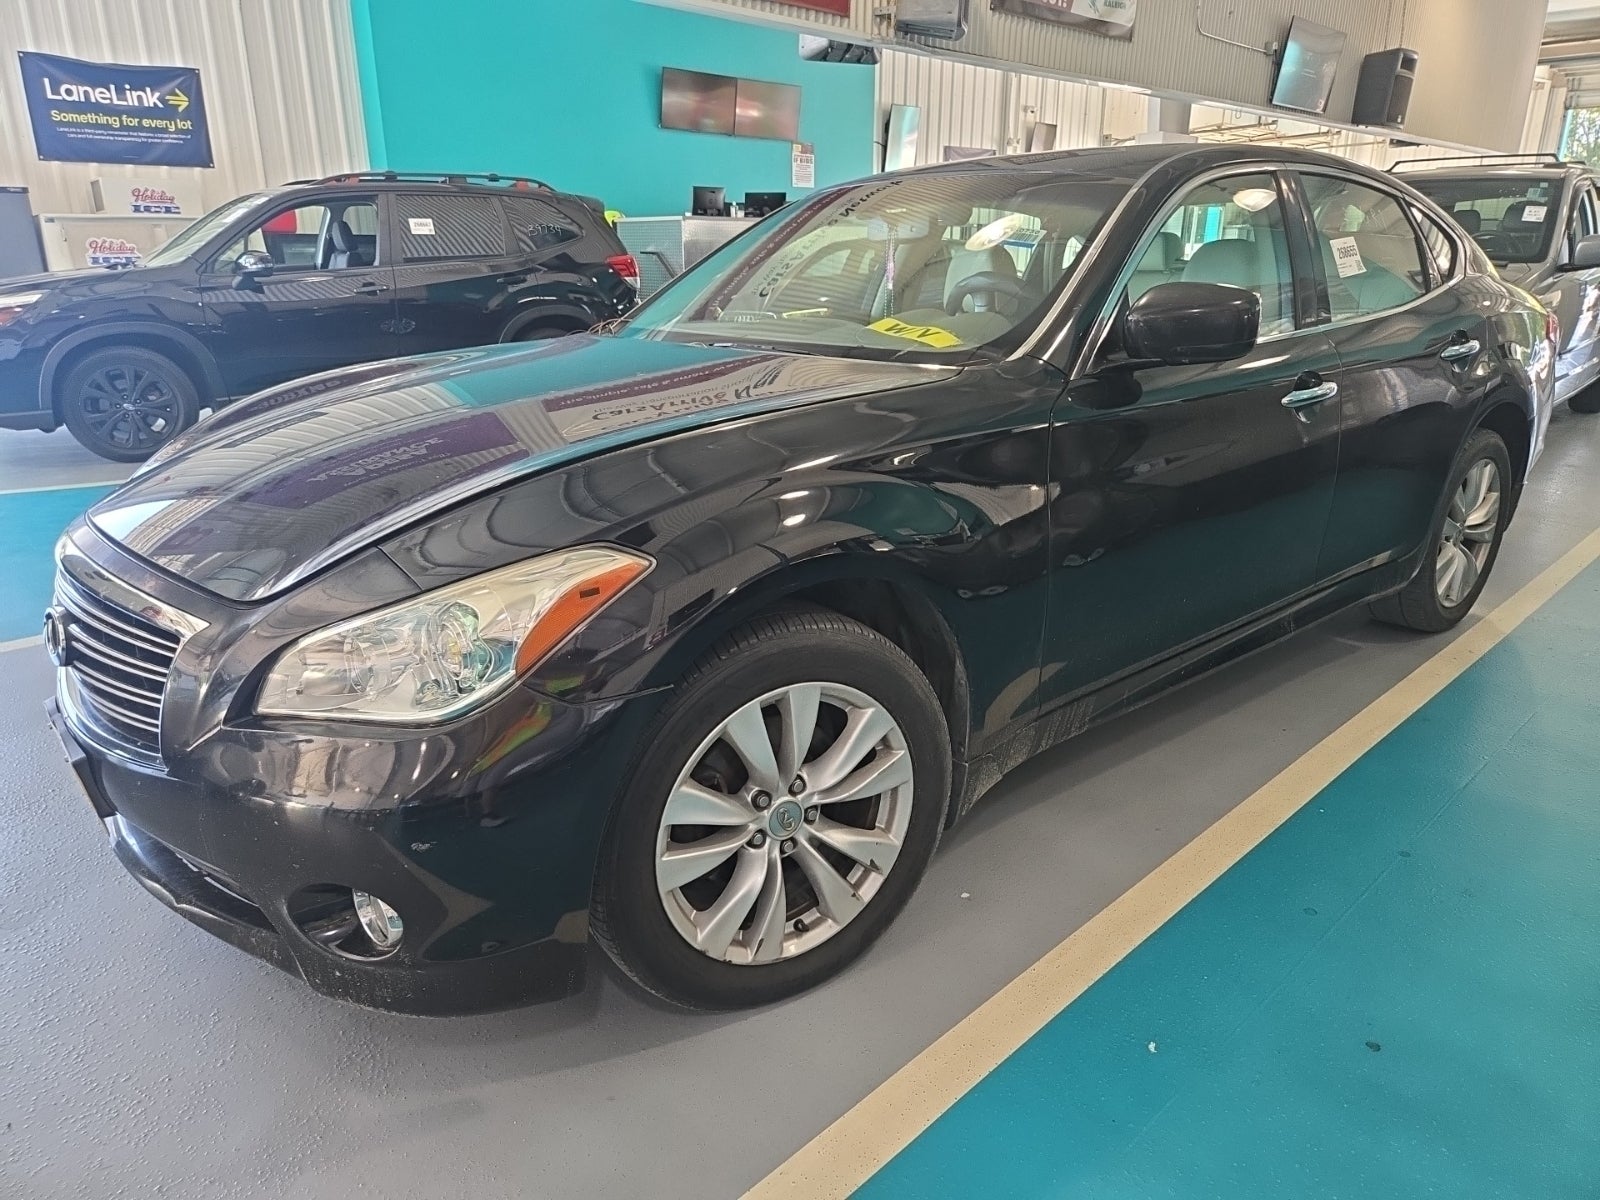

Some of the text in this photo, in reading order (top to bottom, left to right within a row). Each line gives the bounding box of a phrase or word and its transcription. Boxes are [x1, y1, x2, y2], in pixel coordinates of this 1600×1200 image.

[43, 77, 165, 108] LaneLink
[51, 110, 193, 132] Something for every lot
[131, 187, 175, 203] Holiday
[89, 239, 136, 254] Holiday
